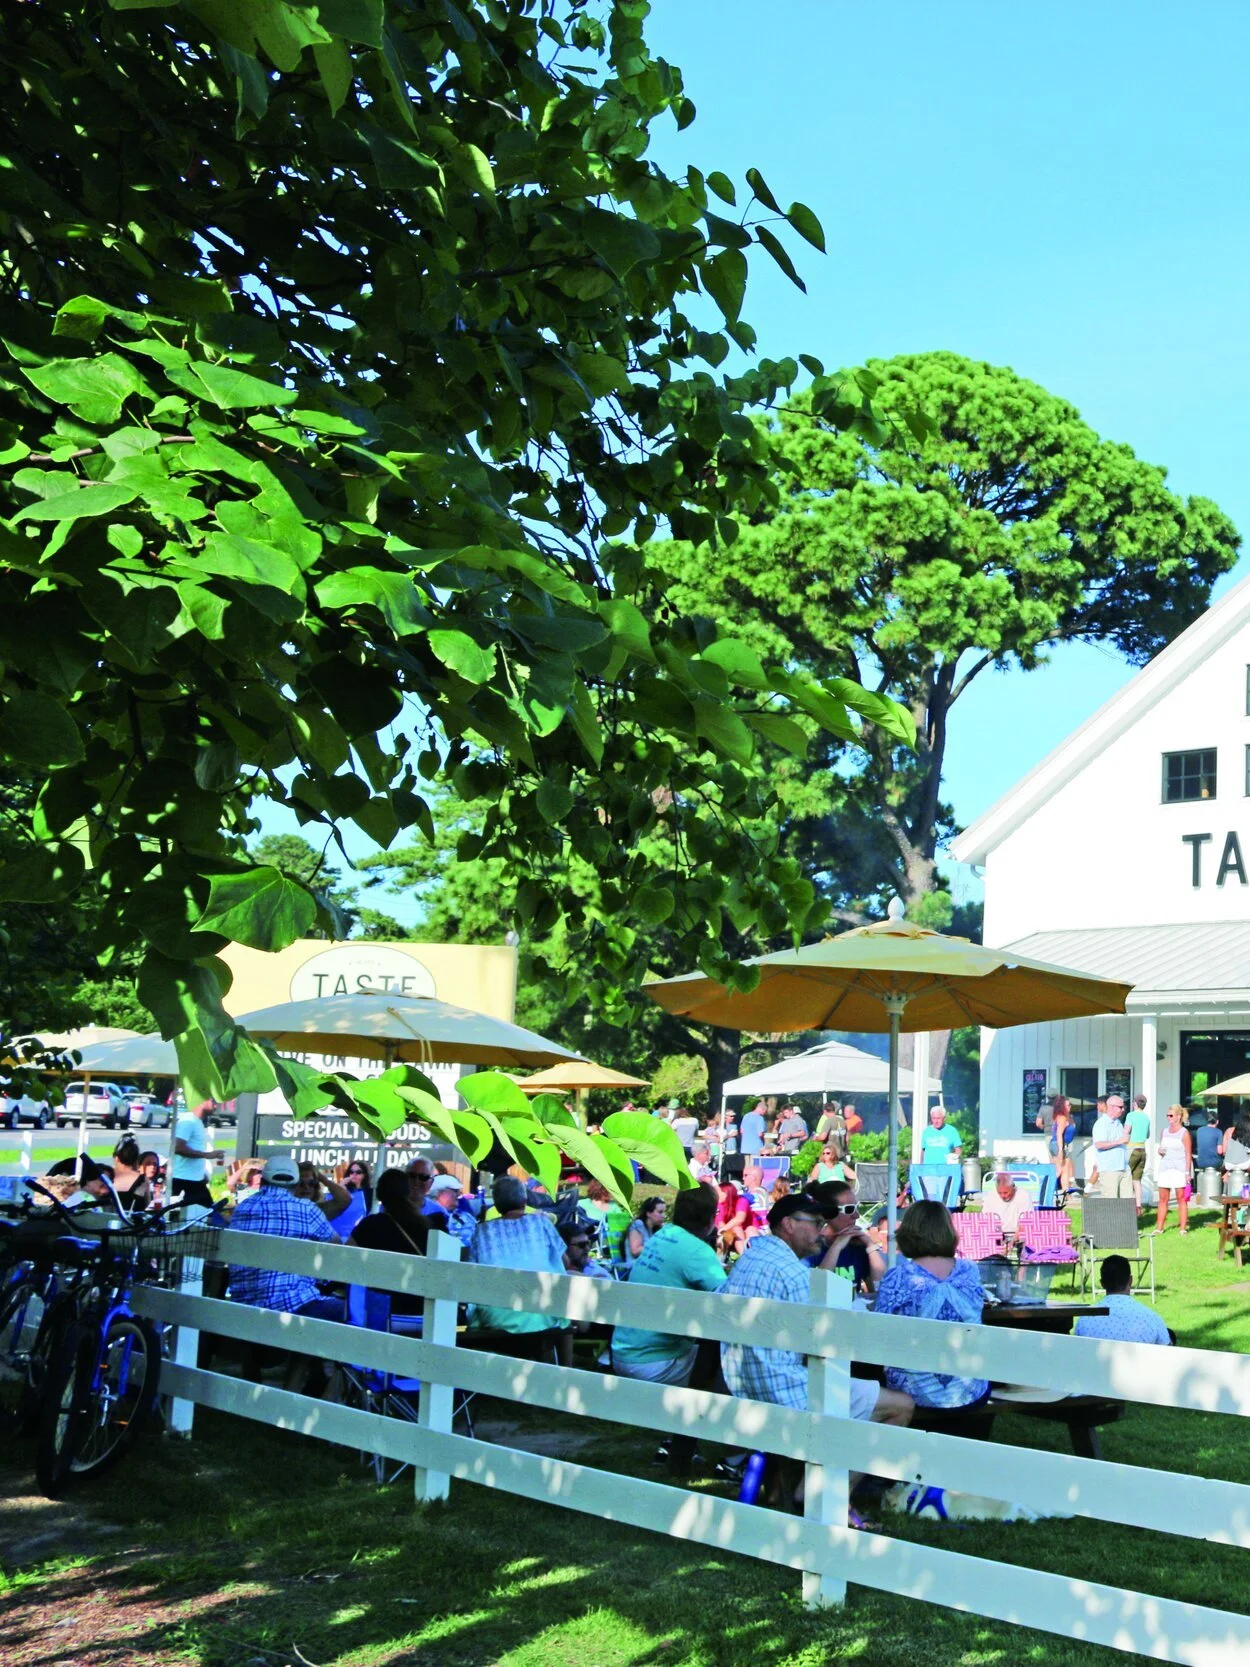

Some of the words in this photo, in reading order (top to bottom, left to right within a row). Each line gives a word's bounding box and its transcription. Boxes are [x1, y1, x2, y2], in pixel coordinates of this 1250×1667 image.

[322, 1055, 346, 1068] ON
[385, 1123, 431, 1141] ODS
[290, 1148, 350, 1167] LUNCH
[386, 1150, 421, 1168] DAY
